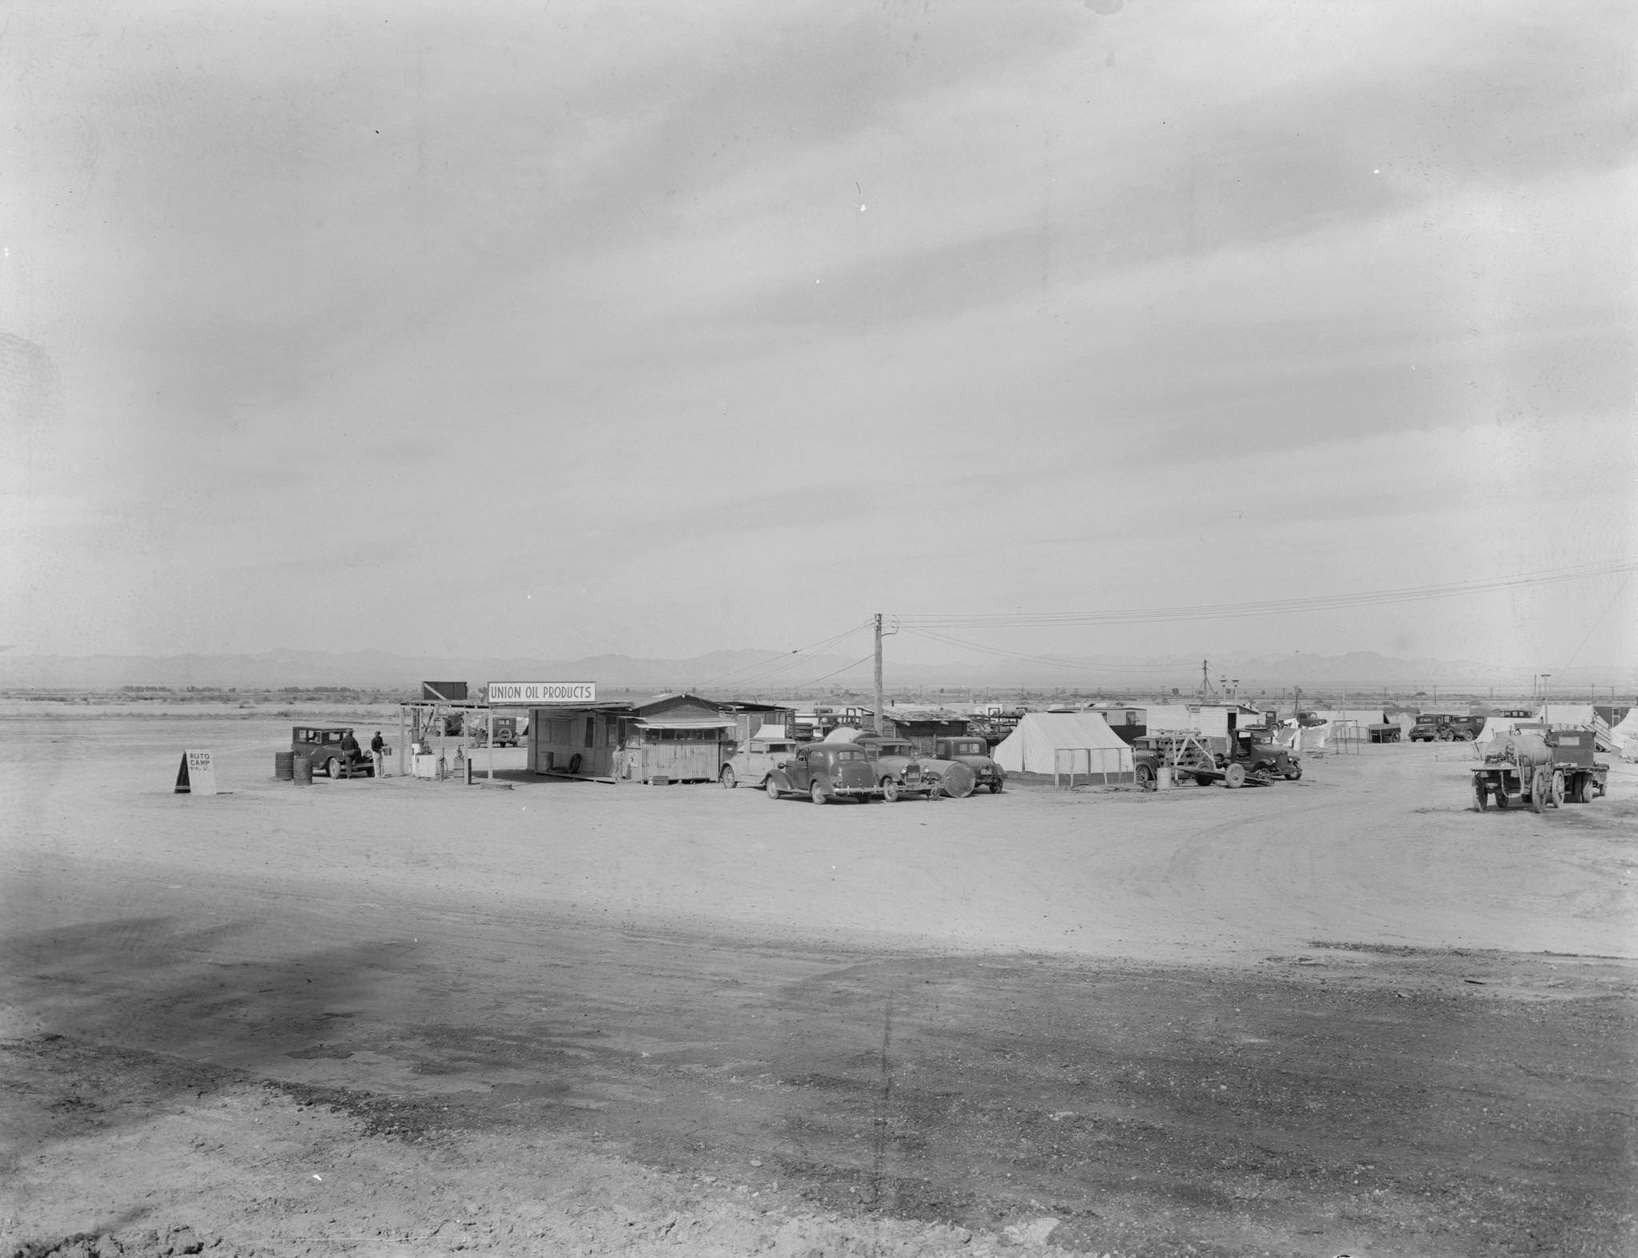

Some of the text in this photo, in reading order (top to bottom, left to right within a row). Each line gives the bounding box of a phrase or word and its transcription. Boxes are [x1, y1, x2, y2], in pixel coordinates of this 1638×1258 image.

[491, 686, 592, 698] UNION OIL PRODUCTS
